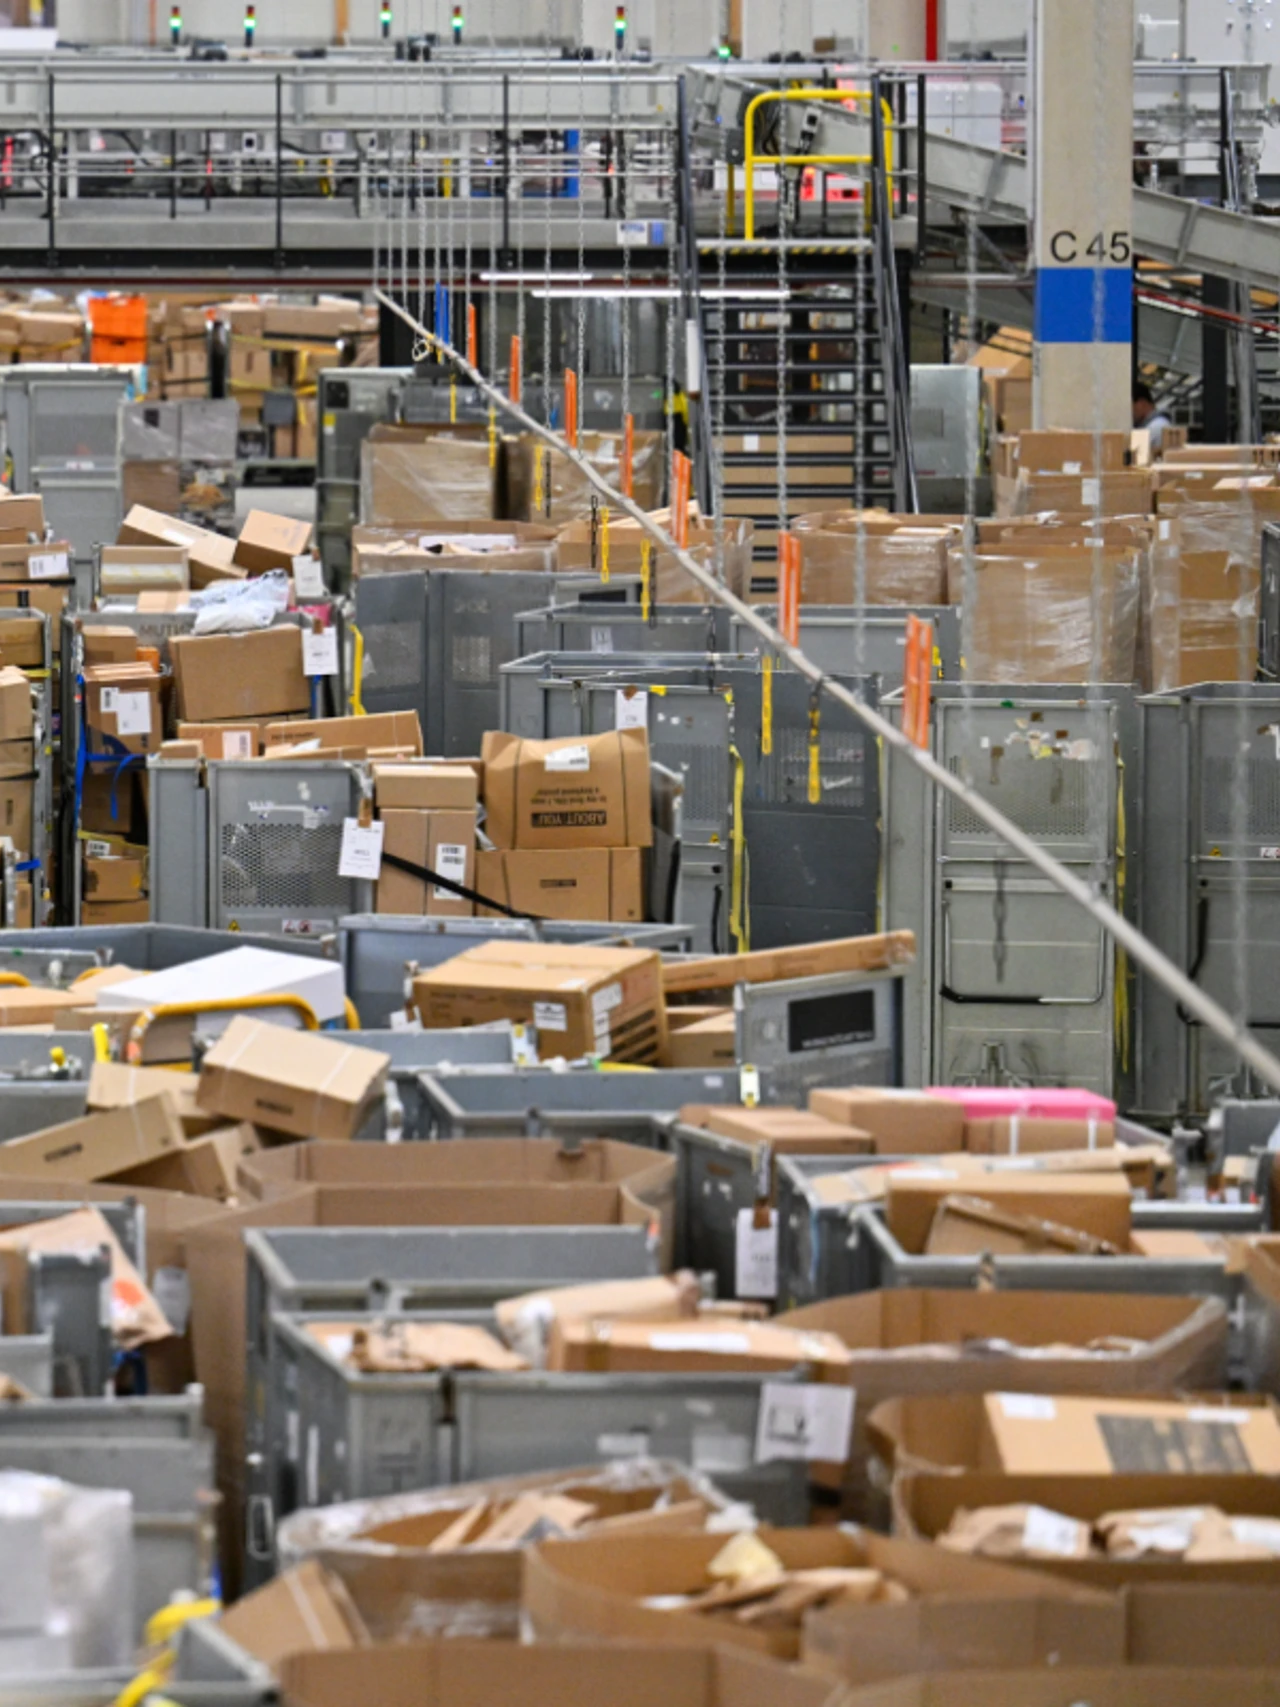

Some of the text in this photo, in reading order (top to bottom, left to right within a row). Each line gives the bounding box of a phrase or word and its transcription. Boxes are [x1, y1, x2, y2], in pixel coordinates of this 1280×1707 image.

[1050, 230, 1130, 263] C 45
[539, 813, 605, 825] ABOUT YOU
